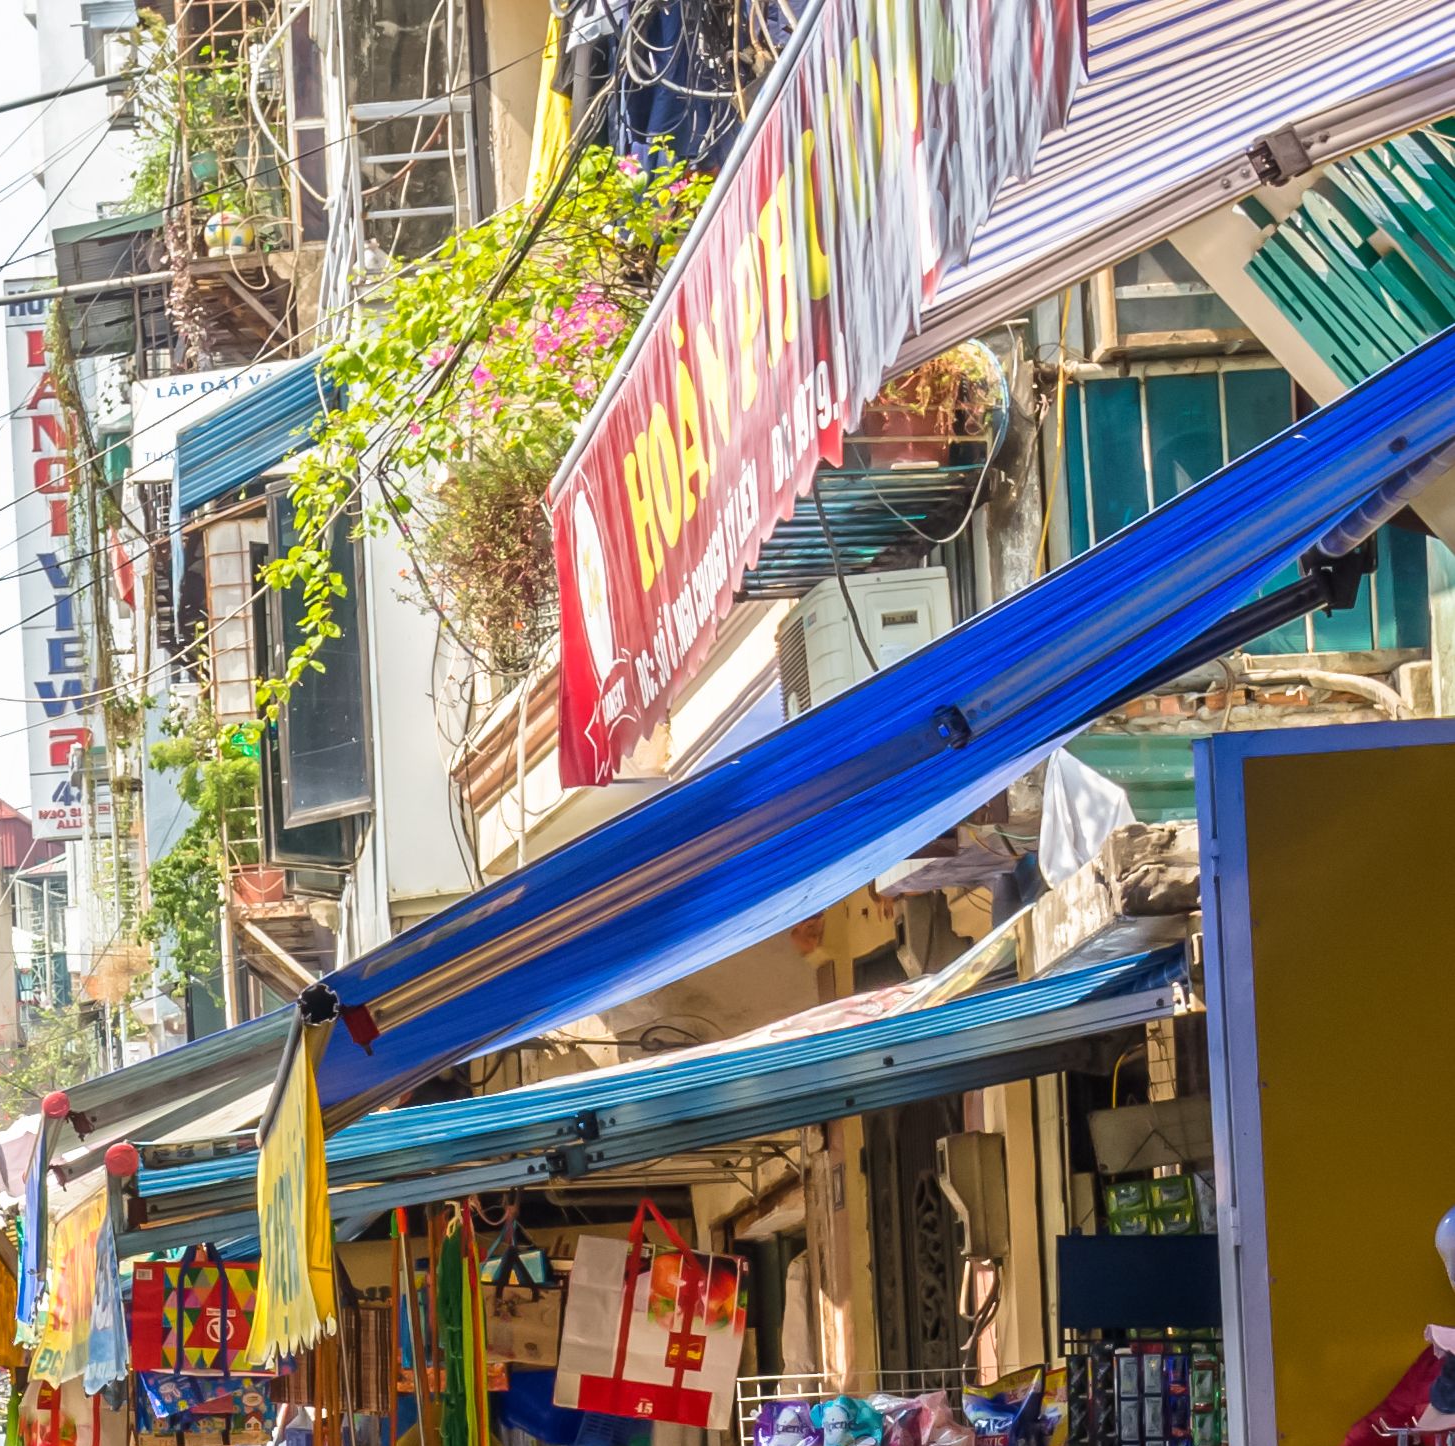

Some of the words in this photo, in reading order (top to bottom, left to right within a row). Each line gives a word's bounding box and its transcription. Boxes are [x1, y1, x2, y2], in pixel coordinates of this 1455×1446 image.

[156, 382, 194, 399] LẮP
[623, 289, 731, 593] HOÀN
[33, 552, 99, 718] VIEW
